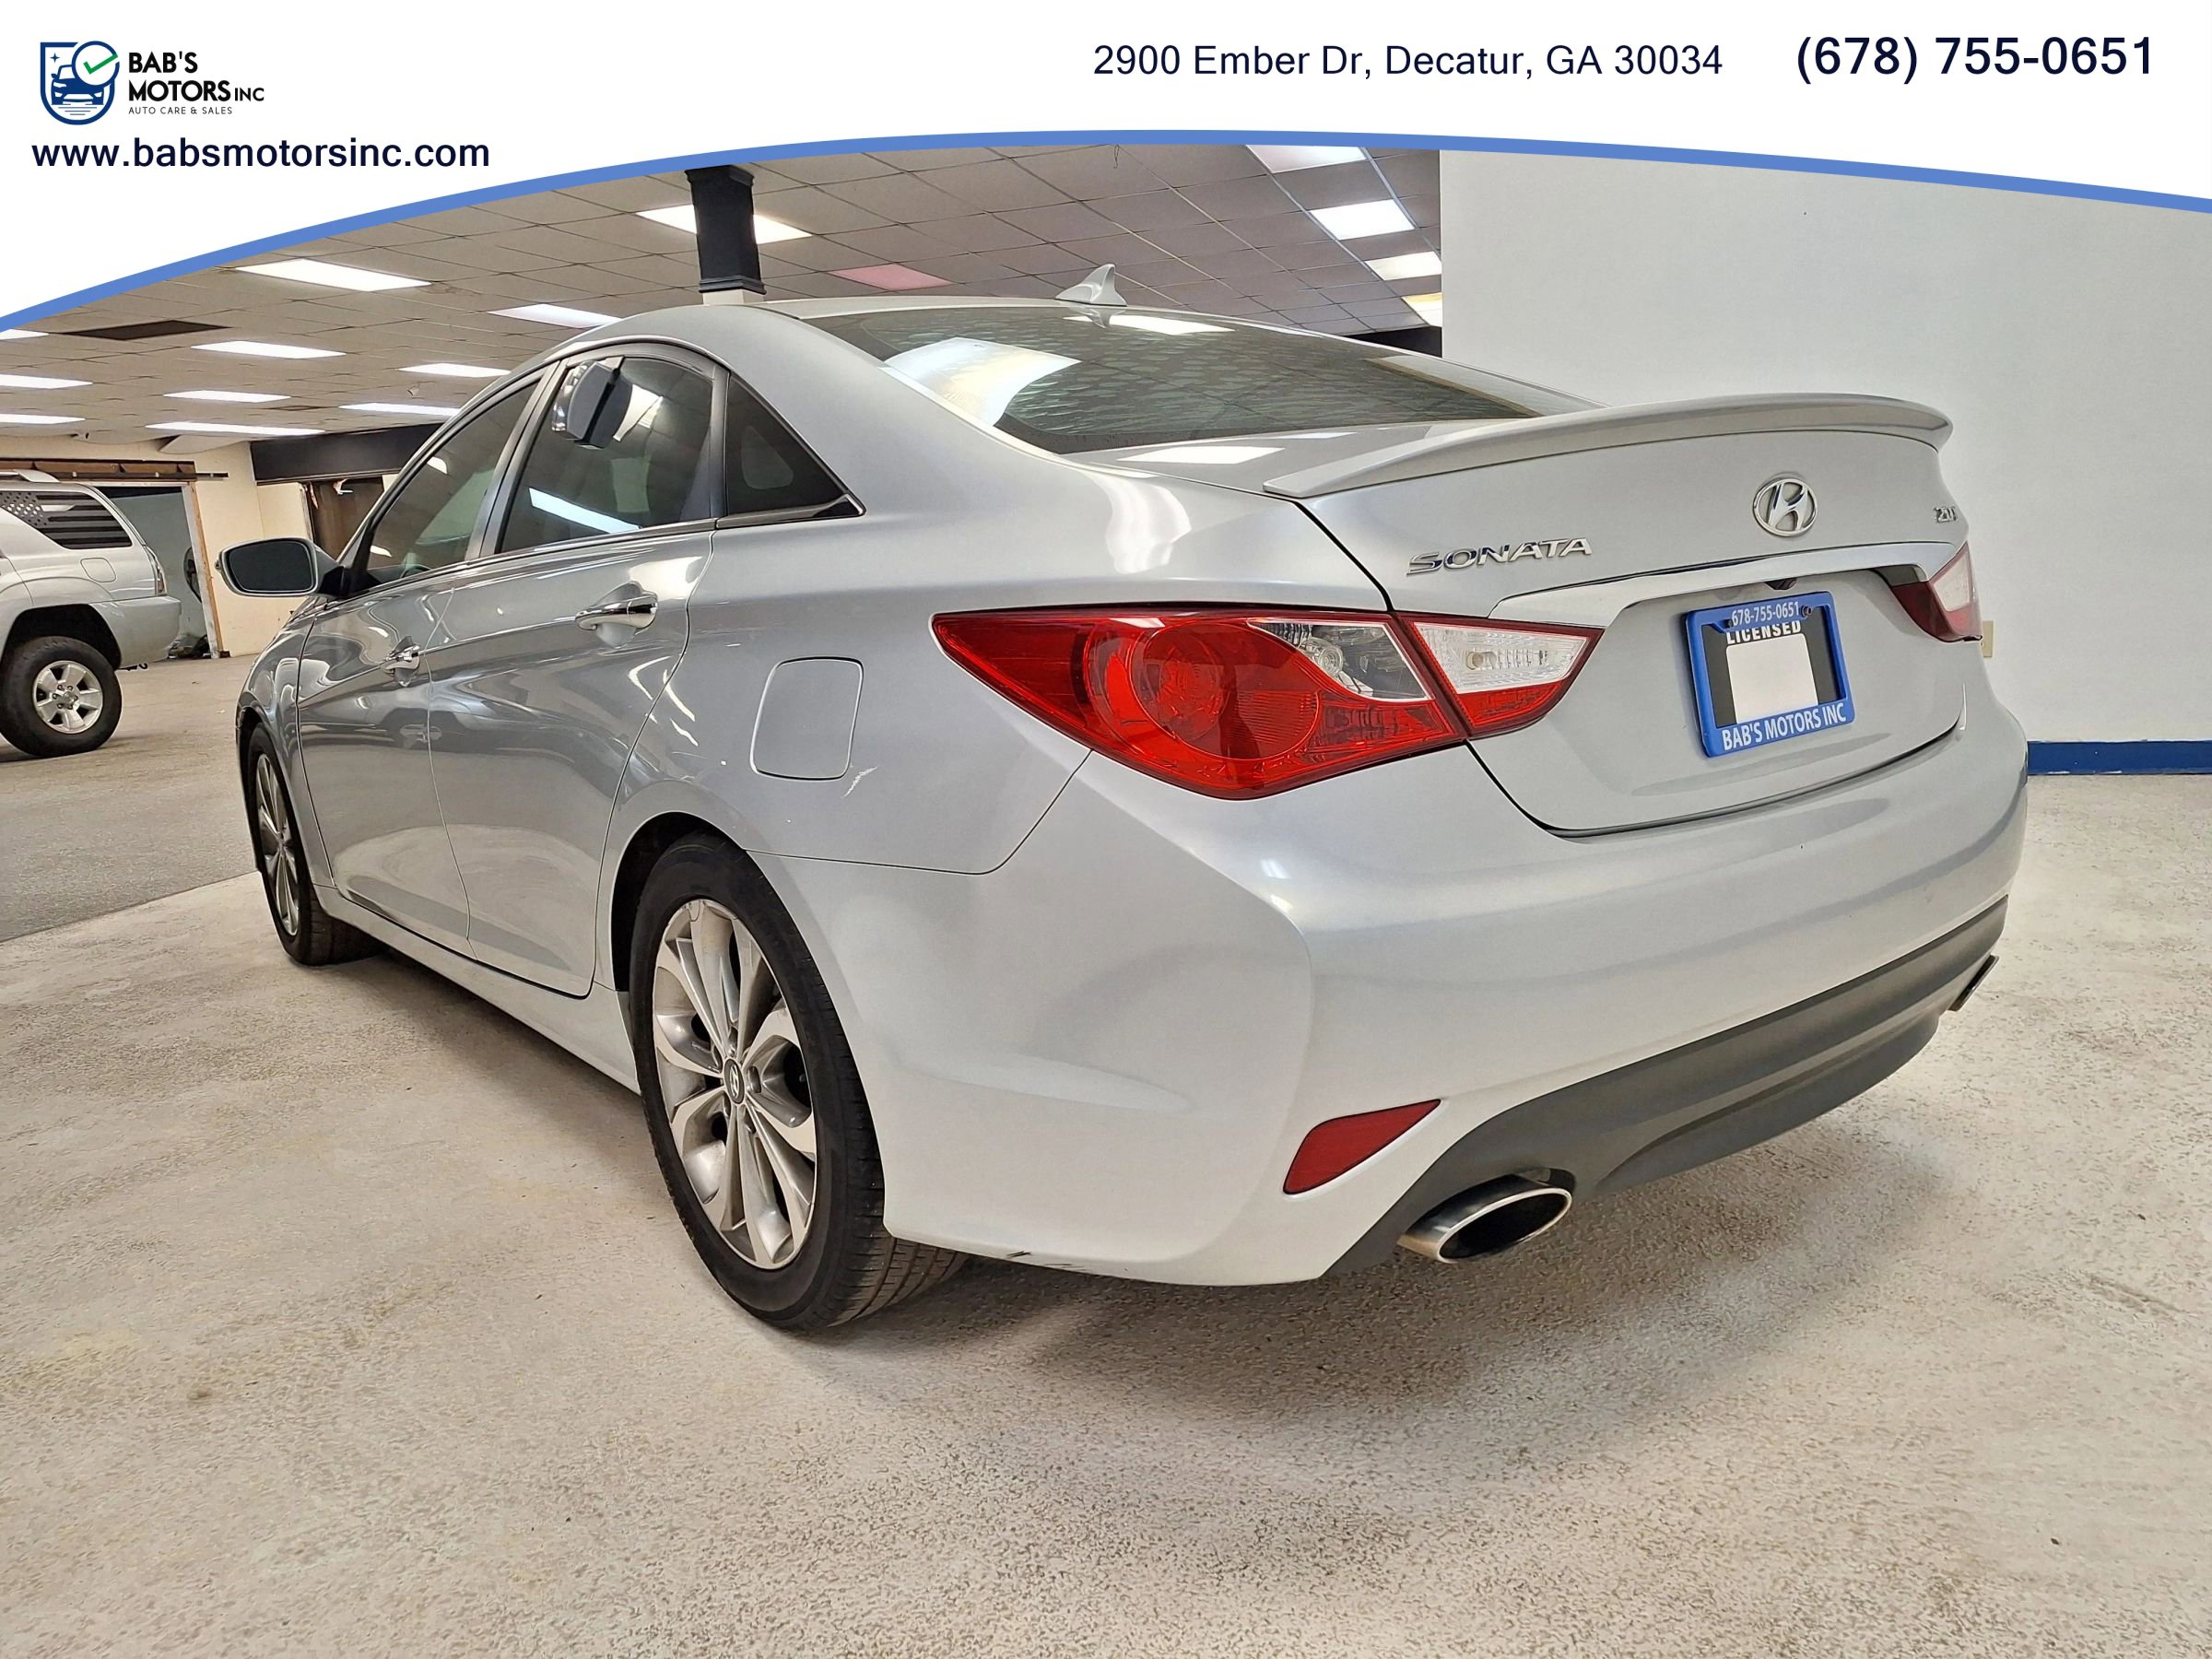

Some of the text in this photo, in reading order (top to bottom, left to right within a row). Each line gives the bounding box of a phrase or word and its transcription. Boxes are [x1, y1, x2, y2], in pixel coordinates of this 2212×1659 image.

[1406, 537, 1593, 576] SONATA
[1732, 602, 1799, 626] 678-755-0651
[1726, 620, 1801, 644] LICENSED
[1723, 702, 1846, 750] BAB'S MOTORS INC
